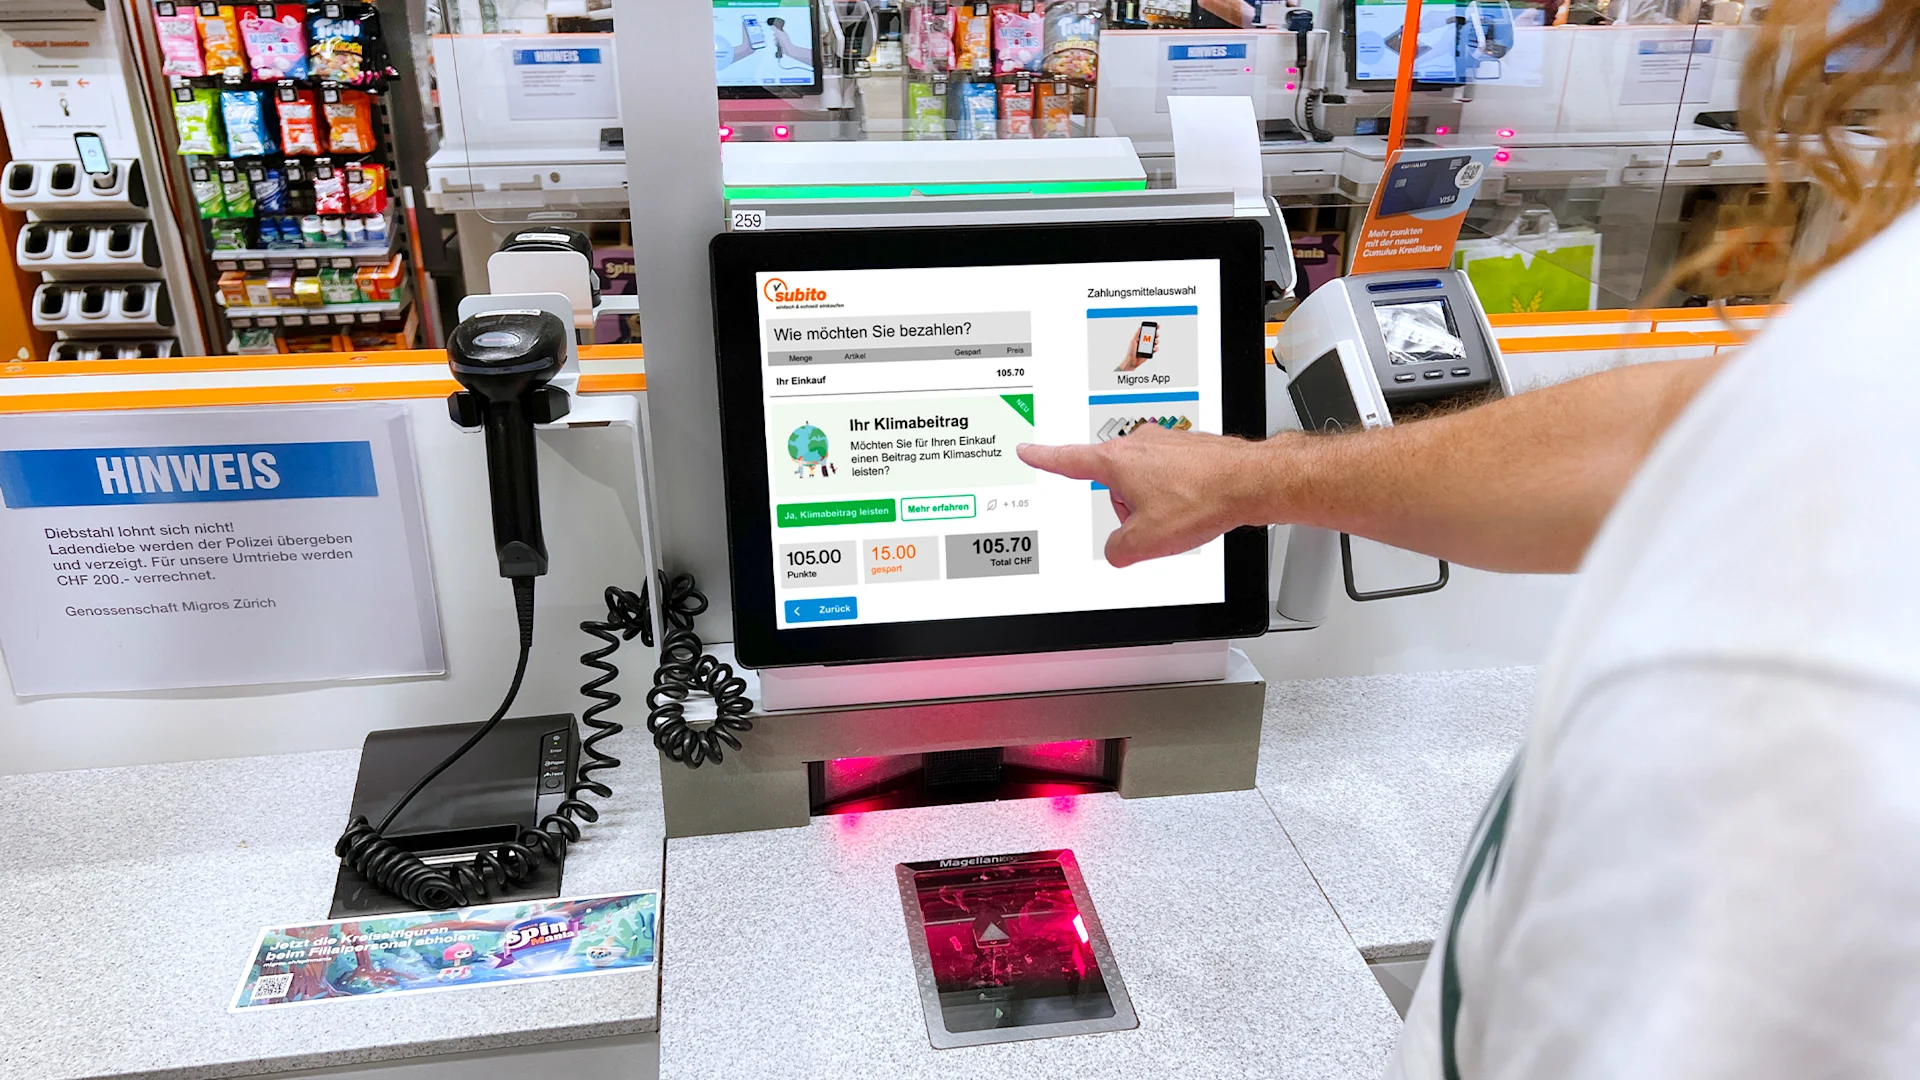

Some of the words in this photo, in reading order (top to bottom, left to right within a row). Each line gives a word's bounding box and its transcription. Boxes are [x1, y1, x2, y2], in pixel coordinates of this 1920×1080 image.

[313, 18, 361, 38] Trolli
[1058, 17, 1096, 37] Trolli
[1440, 195, 1455, 204] VISA
[735, 213, 762, 228] 259
[1368, 229, 1390, 238] Mehr
[1390, 228, 1423, 238] punkten
[1365, 239, 1379, 248] mit
[1380, 238, 1394, 247] der
[1394, 237, 1420, 246] neuen
[1293, 248, 1325, 258] ania
[1363, 247, 1398, 257] Cumulus
[1398, 244, 1443, 255] Kreditkarte
[775, 288, 827, 302] subito
[1088, 285, 1196, 299] Zahlungsmittelauswahl
[774, 328, 802, 341] Wie
[807, 326, 867, 340] möchten
[872, 325, 895, 338] Sie
[900, 322, 972, 337] bezahlen?
[789, 355, 813, 363] Menge
[844, 352, 866, 360] Artikel
[954, 349, 982, 357] Gespart
[776, 377, 789, 386] Ihr
[791, 376, 827, 385] Einkauf
[996, 368, 1025, 377] 105.70
[1117, 375, 1150, 386] Migros
[1151, 374, 1171, 385] App
[1016, 398, 1031, 413] NEU
[849, 418, 871, 432] Ihr
[874, 415, 969, 432] Klimabeitrag
[850, 439, 894, 451] Möchten
[896, 438, 913, 449] Sie
[915, 437, 929, 448] für
[931, 436, 957, 447] Ihren
[959, 434, 996, 446] Einkauf
[851, 453, 879, 464] einen
[881, 451, 917, 463] Beitrag
[919, 451, 940, 461] zum
[943, 448, 1002, 460] Klimaschutz
[95, 452, 281, 495] HINWEIS
[851, 466, 890, 477] leisten?
[908, 505, 930, 513] Mehr
[932, 503, 969, 512] erfahren
[1011, 499, 1029, 508] 1.05
[800, 509, 857, 519] Klimabeitrag
[860, 507, 889, 516] leisten
[45, 526, 114, 539] Diebstahl
[118, 524, 156, 537] lohnt
[160, 523, 190, 536] sich
[194, 521, 235, 535] nicht!
[49, 542, 135, 555] Ladendiebe
[139, 539, 193, 552] werden
[198, 538, 221, 550] der
[226, 536, 273, 549] Polizei
[277, 534, 353, 548] übergeben
[973, 536, 1032, 554] 105.70
[53, 559, 81, 571] und
[85, 558, 147, 571] verzeigt.
[152, 556, 175, 568] Für
[180, 554, 228, 566] unsere
[233, 551, 298, 564] Umtriebe
[301, 549, 353, 561] werden
[787, 549, 841, 566] 105.00
[871, 544, 916, 561] 15.00
[990, 558, 1012, 567] Total
[1013, 557, 1032, 565] CHF
[787, 570, 817, 579] Punkte
[871, 565, 903, 575] gespart
[57, 574, 88, 586] CHF
[93, 574, 130, 585] 200.-
[134, 570, 216, 584] verrechnet.
[65, 602, 178, 617] Genossenschaft
[182, 599, 230, 613] Migros
[233, 597, 276, 610] Zürich
[819, 605, 851, 614] Zurück
[940, 856, 999, 868] Magellan
[269, 939, 310, 951] Jetzt
[313, 936, 338, 946] die
[340, 927, 449, 943] Kreiselfiguren
[505, 921, 568, 950] Spin
[531, 930, 575, 946] Mania
[265, 950, 305, 962] beim
[308, 938, 412, 957] Filialpersonal
[415, 932, 480, 946] abholen.
